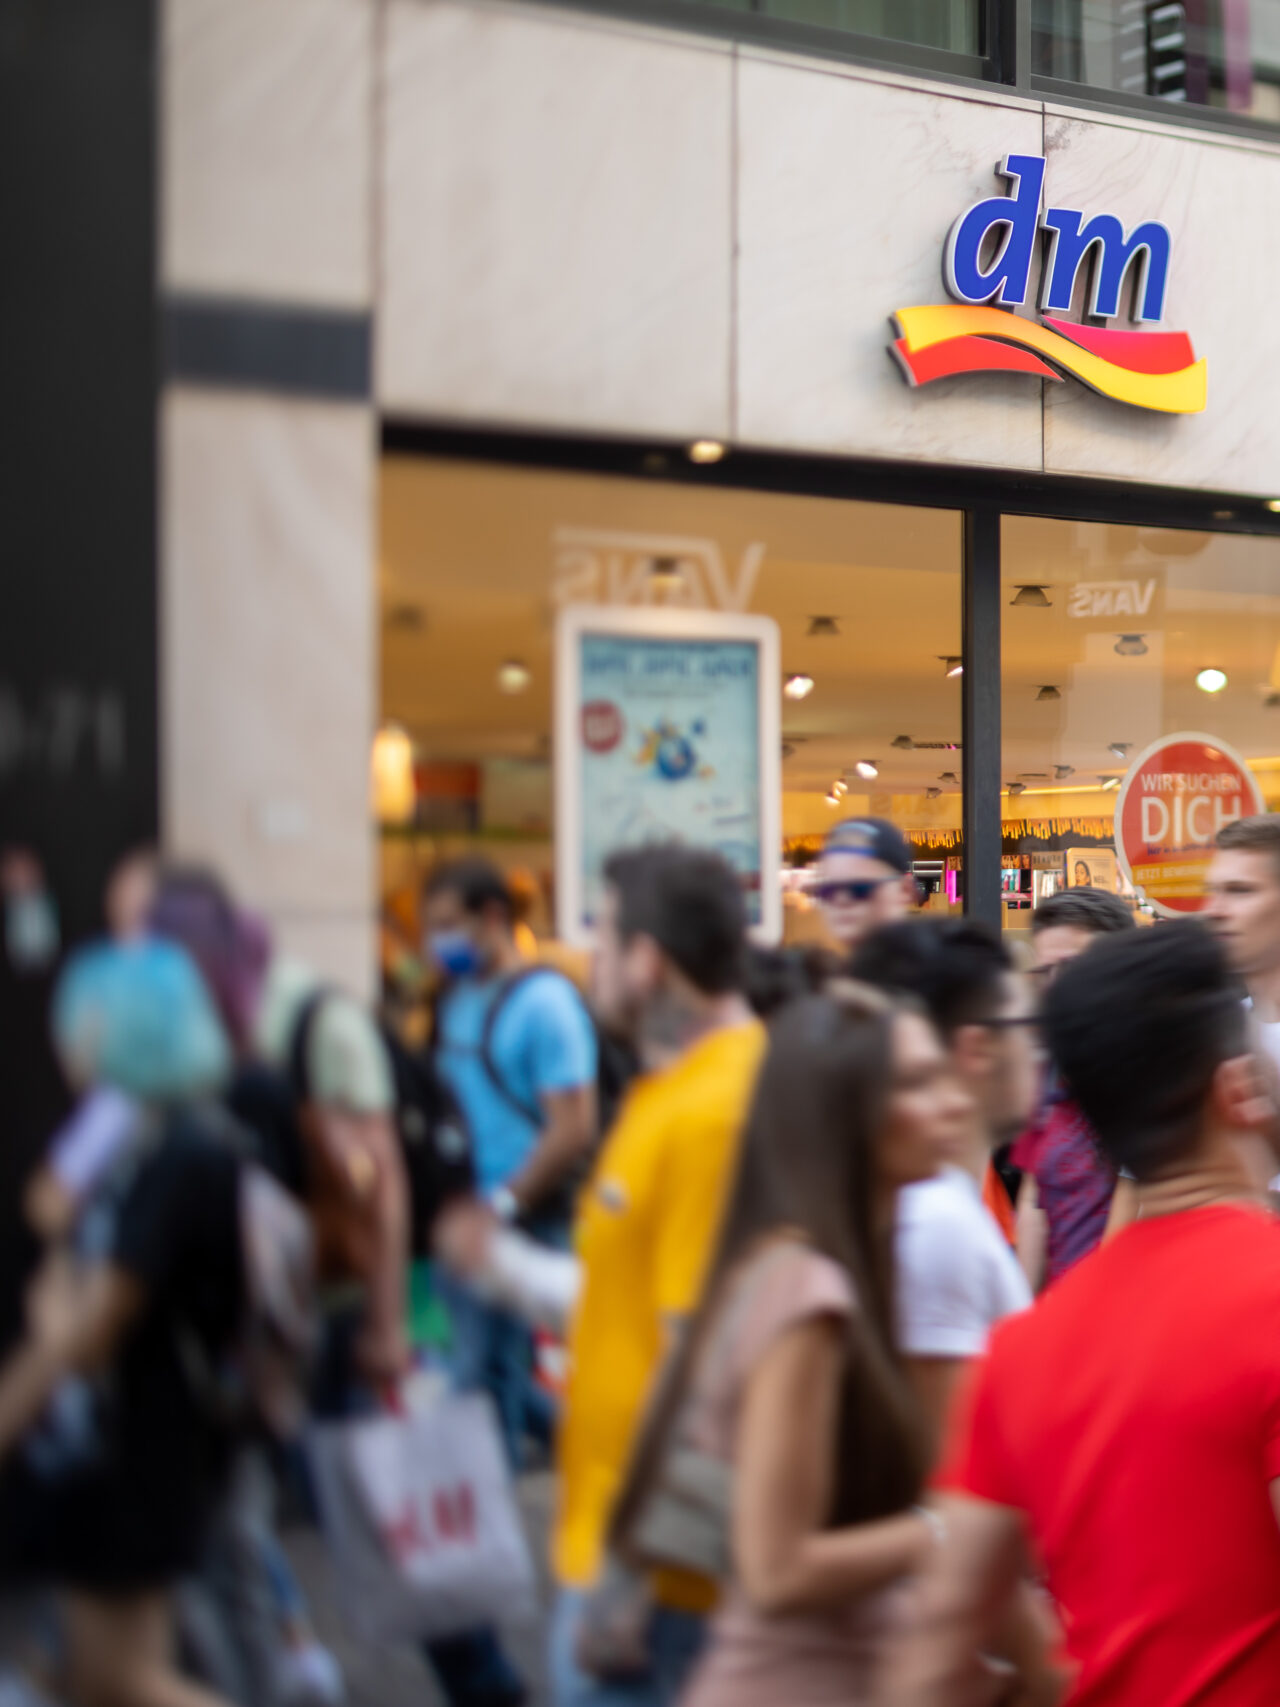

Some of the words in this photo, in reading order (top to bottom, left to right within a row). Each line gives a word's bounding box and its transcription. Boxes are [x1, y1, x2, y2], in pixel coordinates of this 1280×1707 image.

[944, 153, 1171, 323] dm
[1141, 773, 1174, 792] WIR
[1177, 773, 1242, 793] SUCHEN
[1141, 796, 1242, 844] DICH
